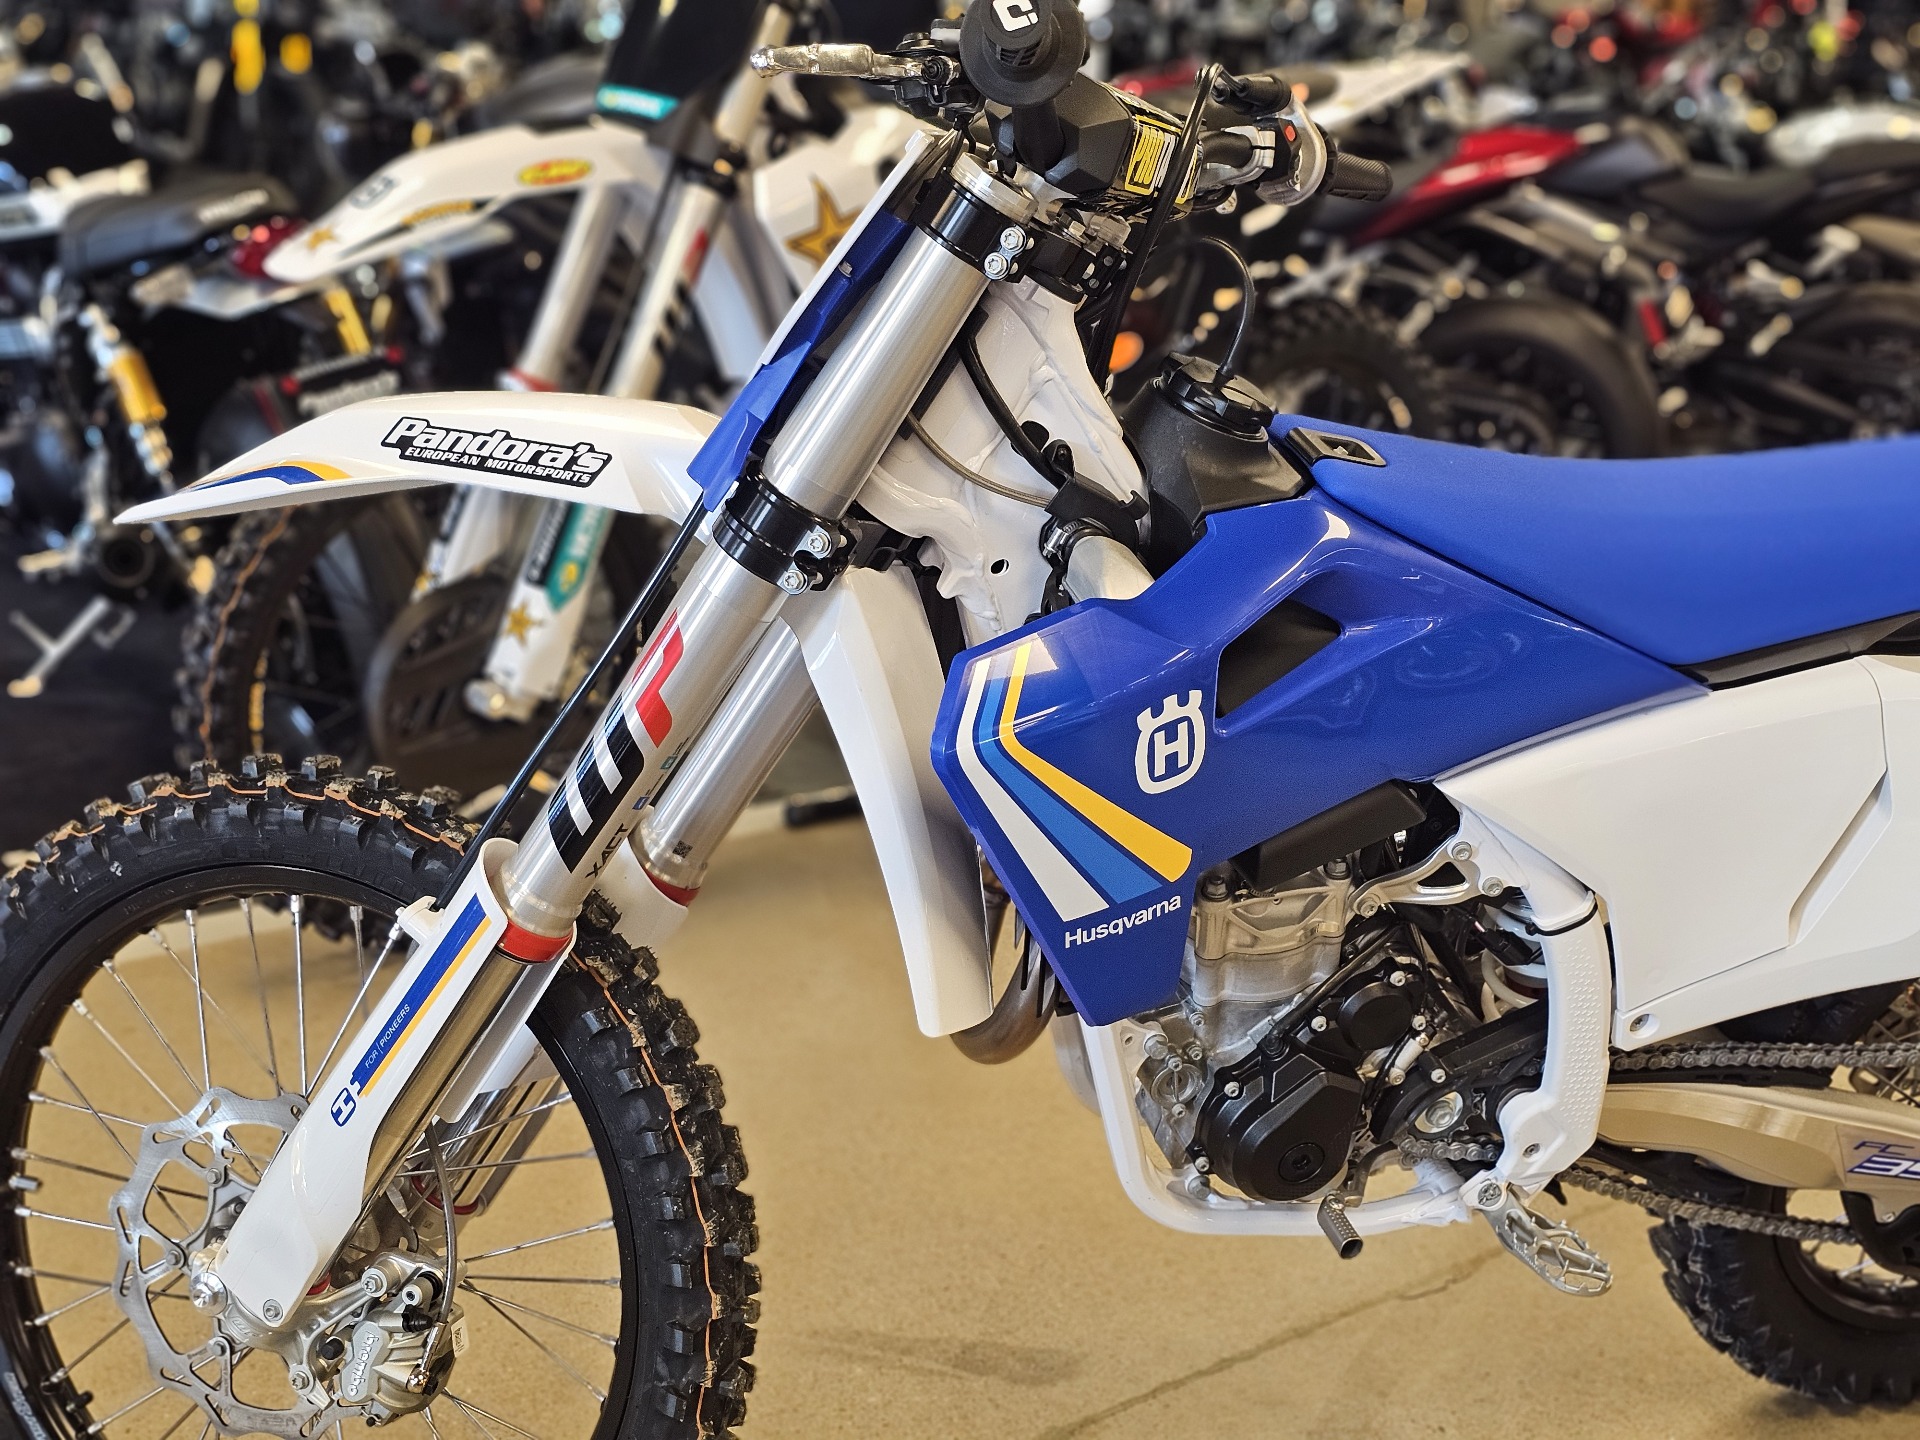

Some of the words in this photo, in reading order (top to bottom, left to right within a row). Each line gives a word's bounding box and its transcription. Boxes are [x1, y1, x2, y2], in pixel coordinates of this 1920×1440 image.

[385, 418, 608, 473] Pandora's
[405, 447, 481, 466] EUROPEAN
[485, 458, 592, 484] MOTORSPORTS
[585, 823, 629, 879] XACT
[1064, 895, 1181, 949] Husqvarna
[364, 1049, 379, 1069] FOR
[379, 1003, 411, 1048] PIONEERS
[1853, 1141, 1915, 1156] FC
[349, 1330, 380, 1397] brembo
